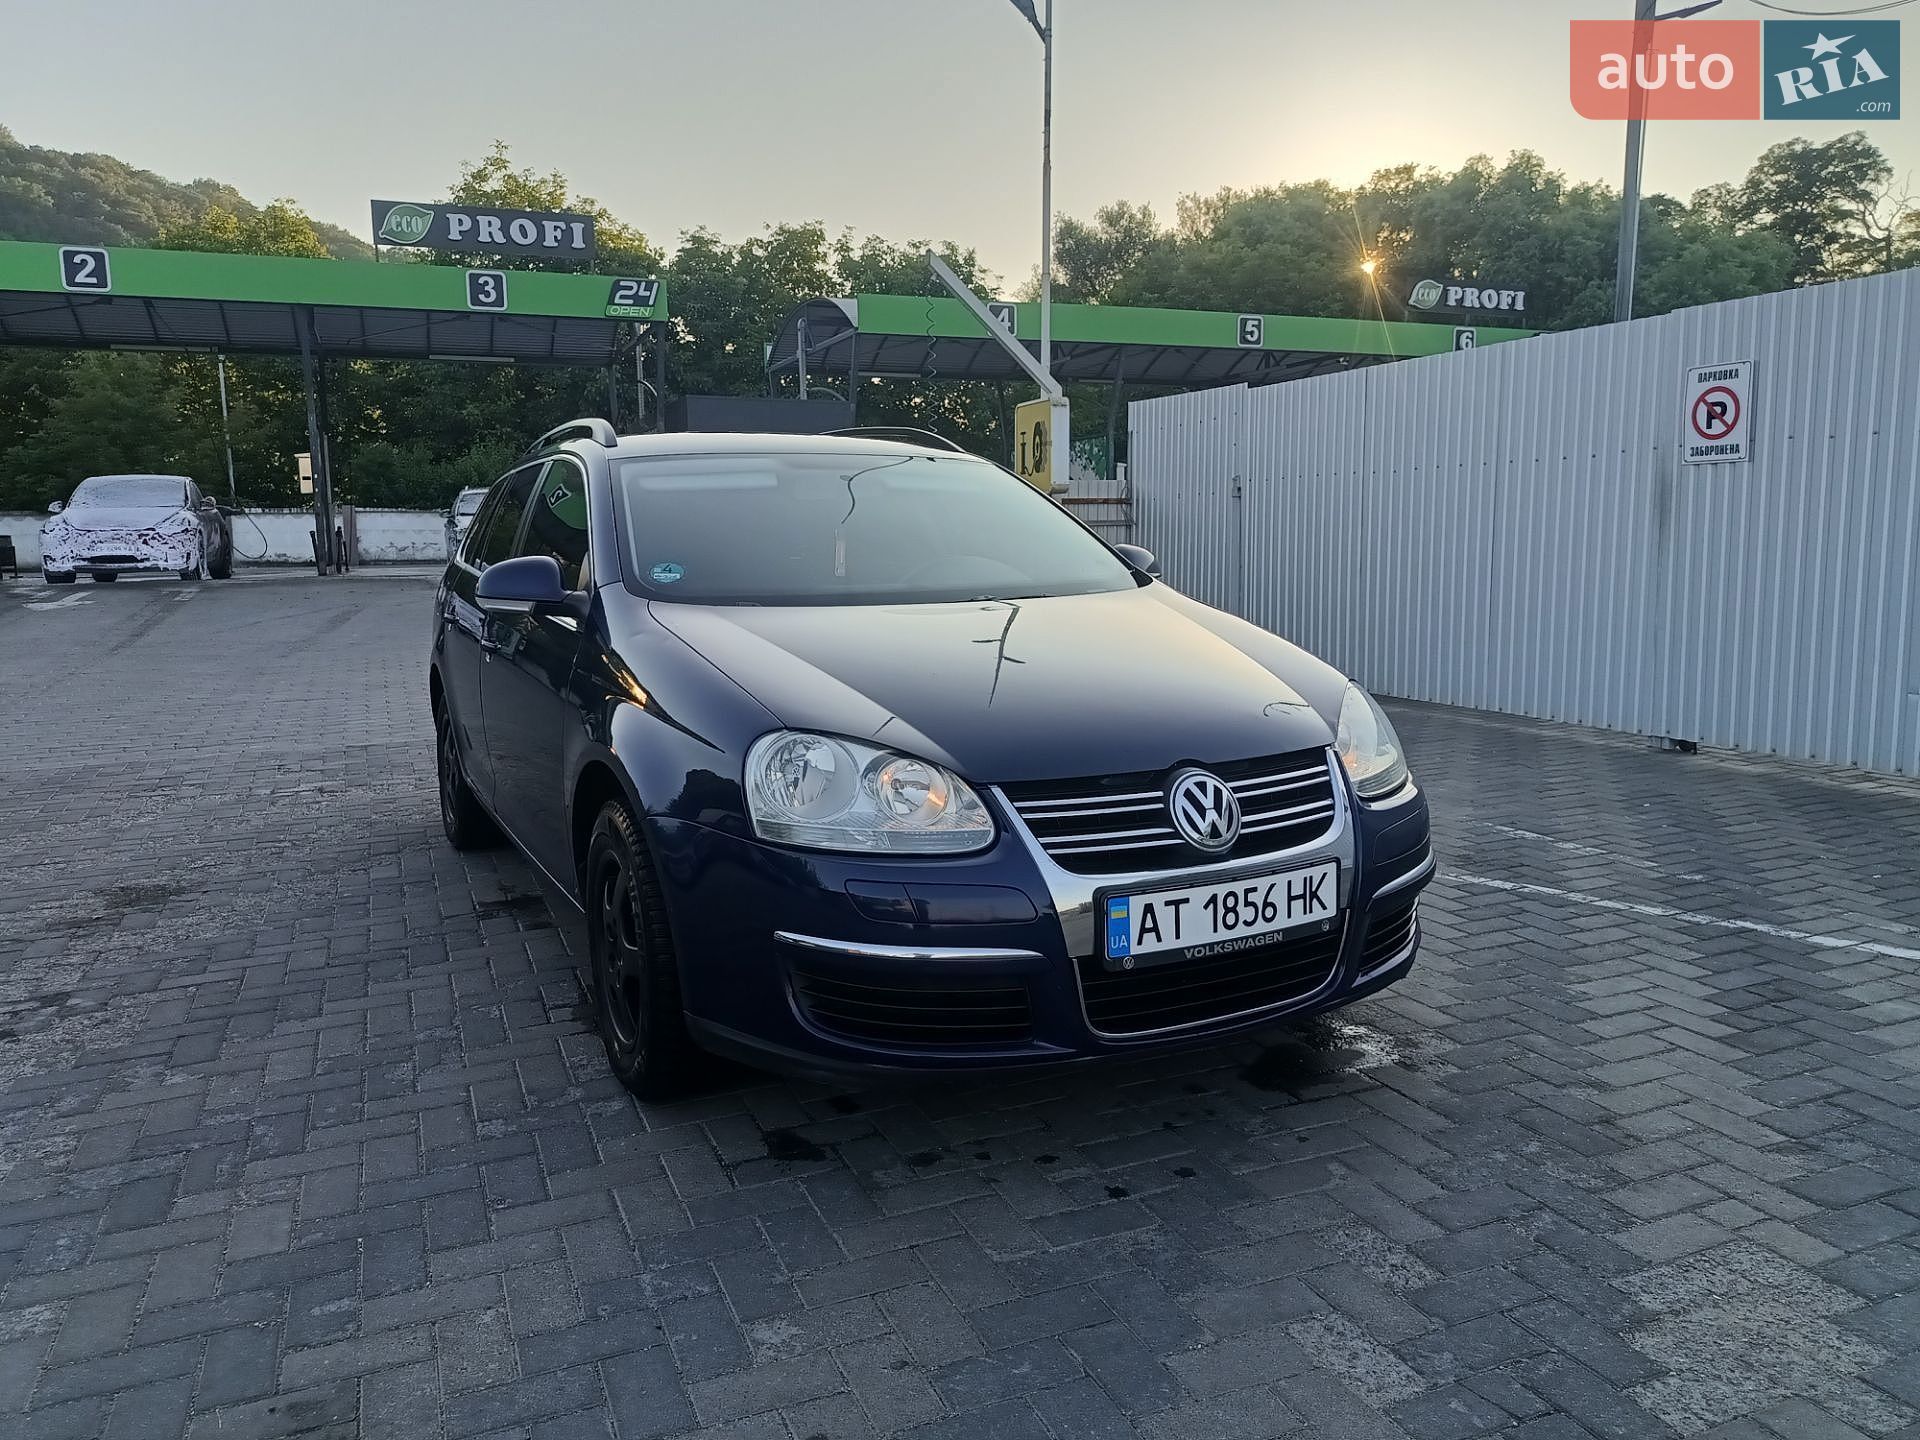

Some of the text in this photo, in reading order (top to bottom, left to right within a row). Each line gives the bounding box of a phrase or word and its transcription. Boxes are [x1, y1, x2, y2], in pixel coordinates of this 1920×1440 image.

[390, 212, 586, 249] eco PROFI
[73, 253, 98, 284] 2
[478, 276, 497, 303] 3
[614, 280, 659, 305] 24
[1446, 287, 1525, 311] PROFI
[609, 306, 651, 316] OPEN
[998, 307, 1012, 331] 4
[1245, 320, 1259, 341] 5
[1460, 332, 1473, 350] 6
[1697, 368, 1739, 383] ПАРКОВКА
[1690, 443, 1740, 457] ЗАБОРОНЕНА
[663, 563, 673, 573] 4
[1136, 872, 1328, 946] AT 1856 HK
[1111, 934, 1129, 949] UA
[1183, 931, 1284, 960] VOLKSWAGEN
